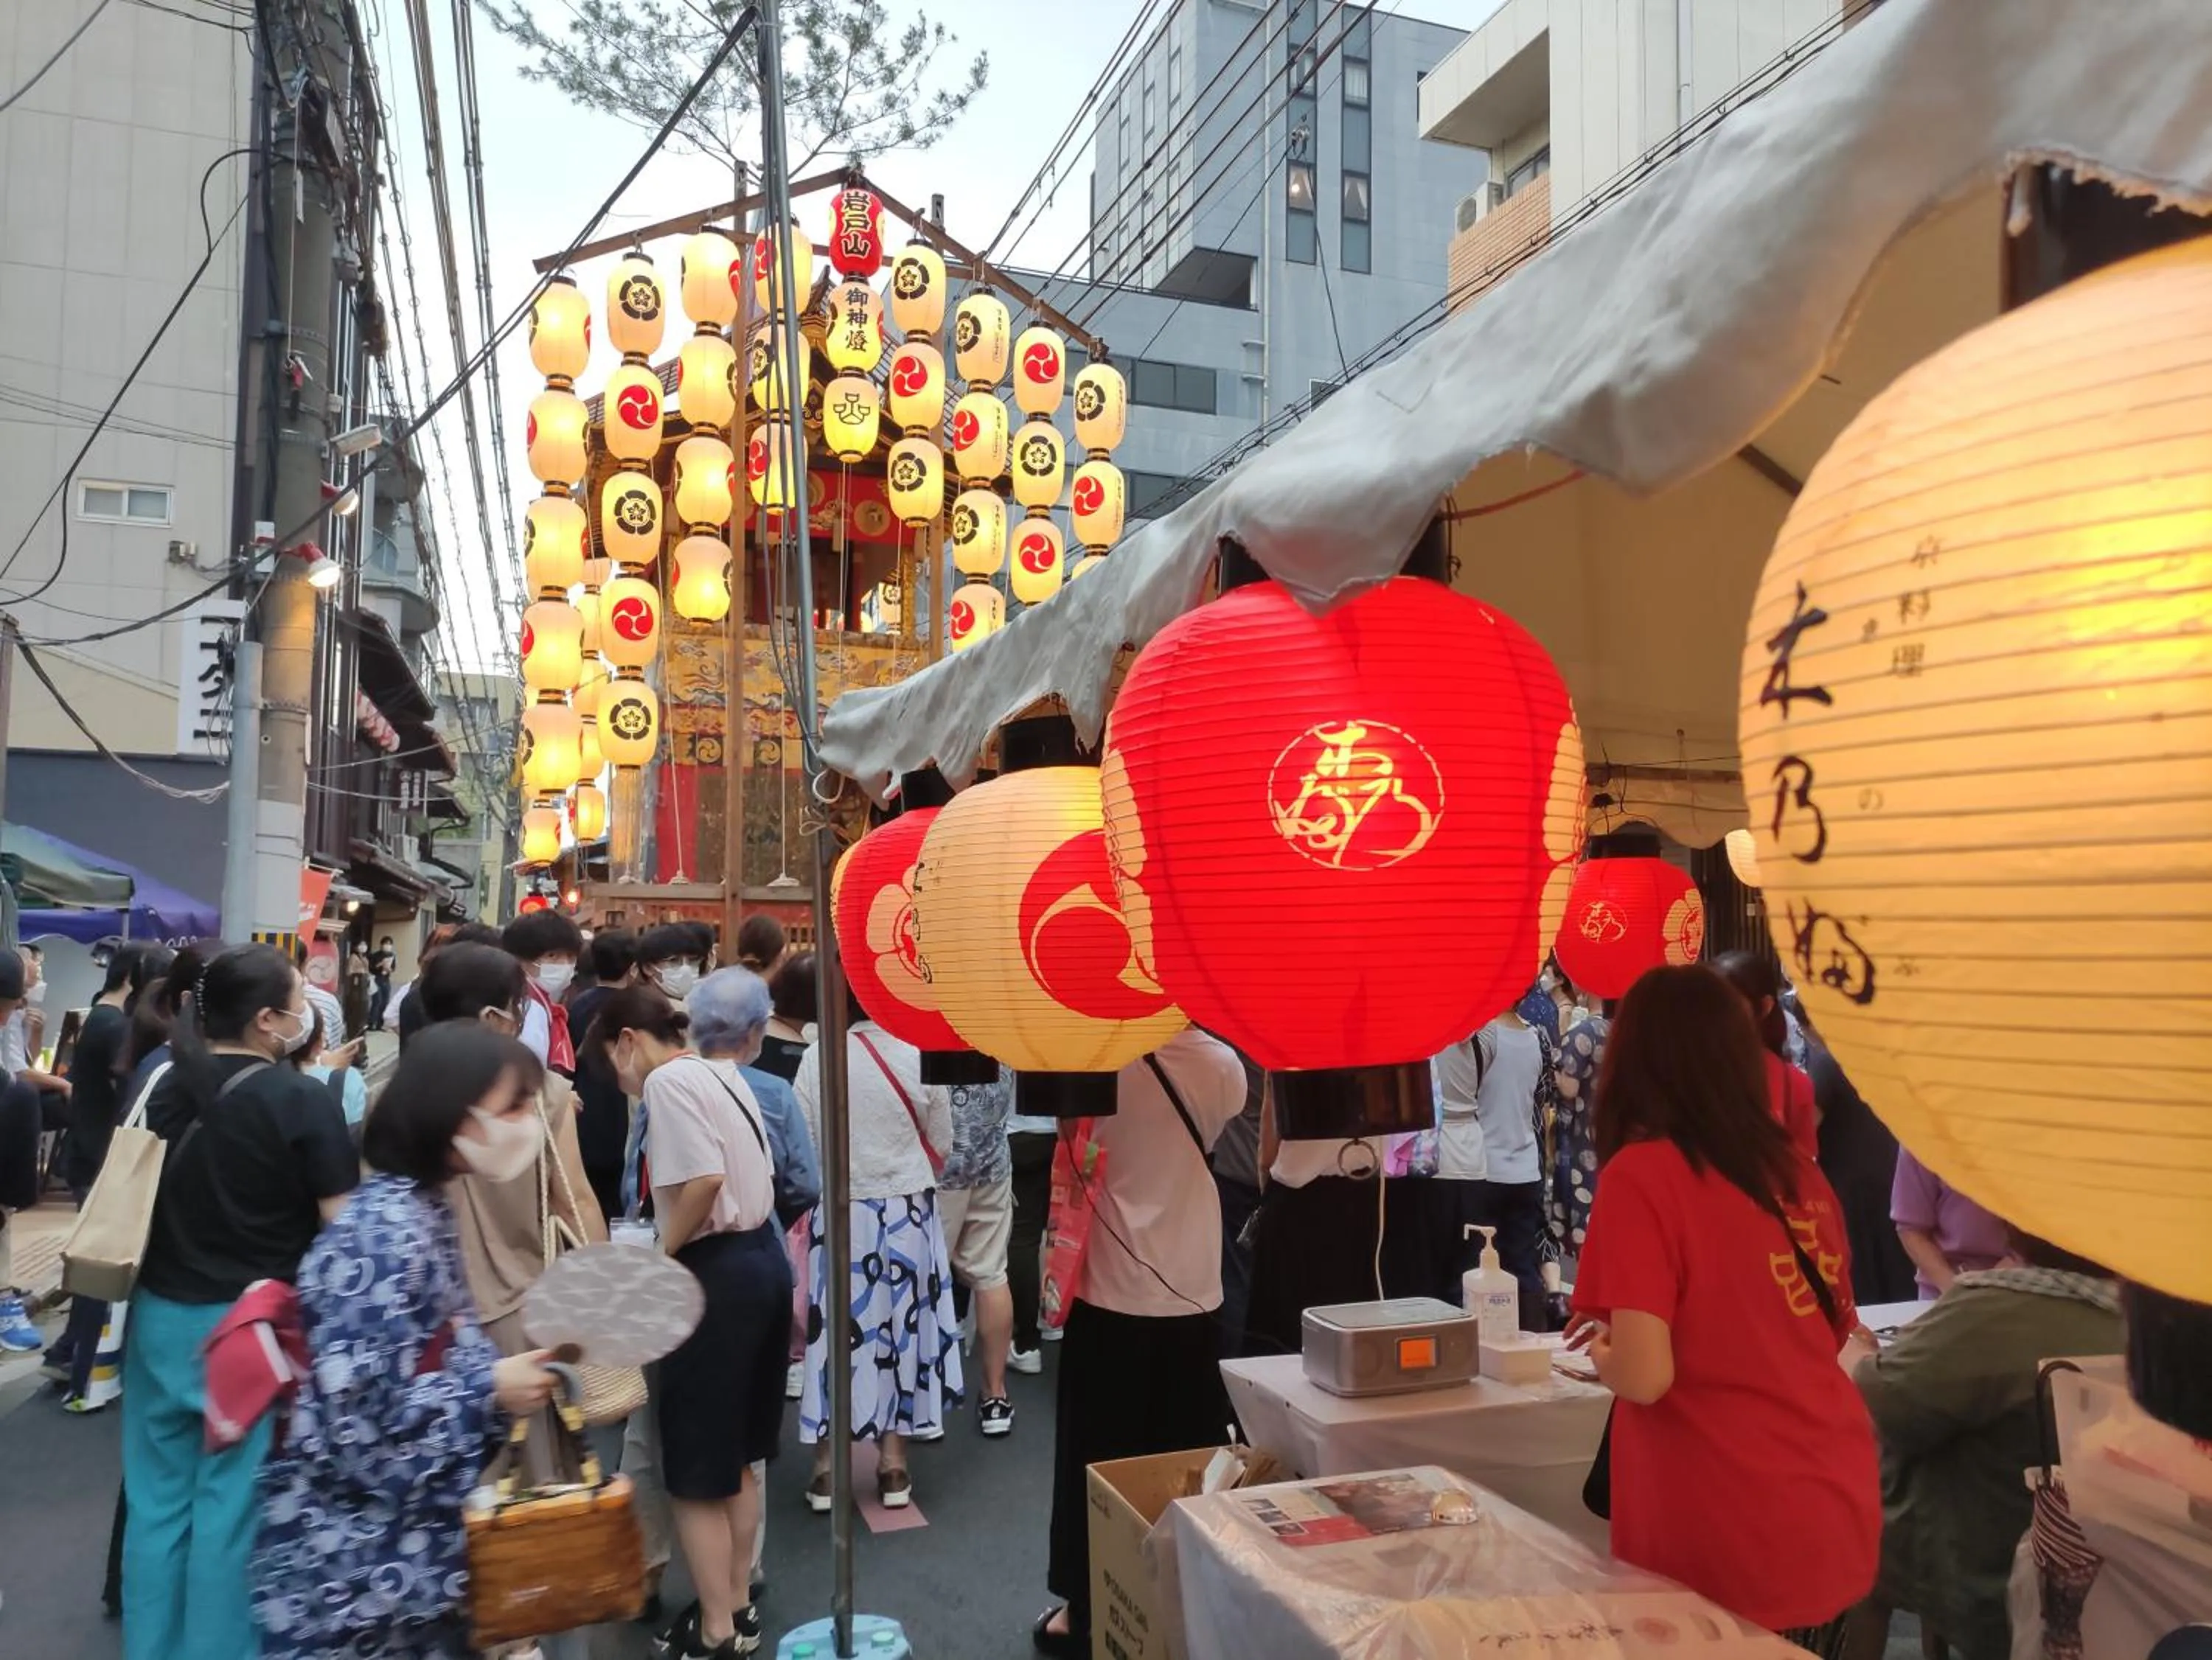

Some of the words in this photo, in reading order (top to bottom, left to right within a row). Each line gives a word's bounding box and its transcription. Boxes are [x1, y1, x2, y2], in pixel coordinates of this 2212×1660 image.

[841, 189, 872, 259] 岩戸山
[846, 287, 869, 352] 御神燈
